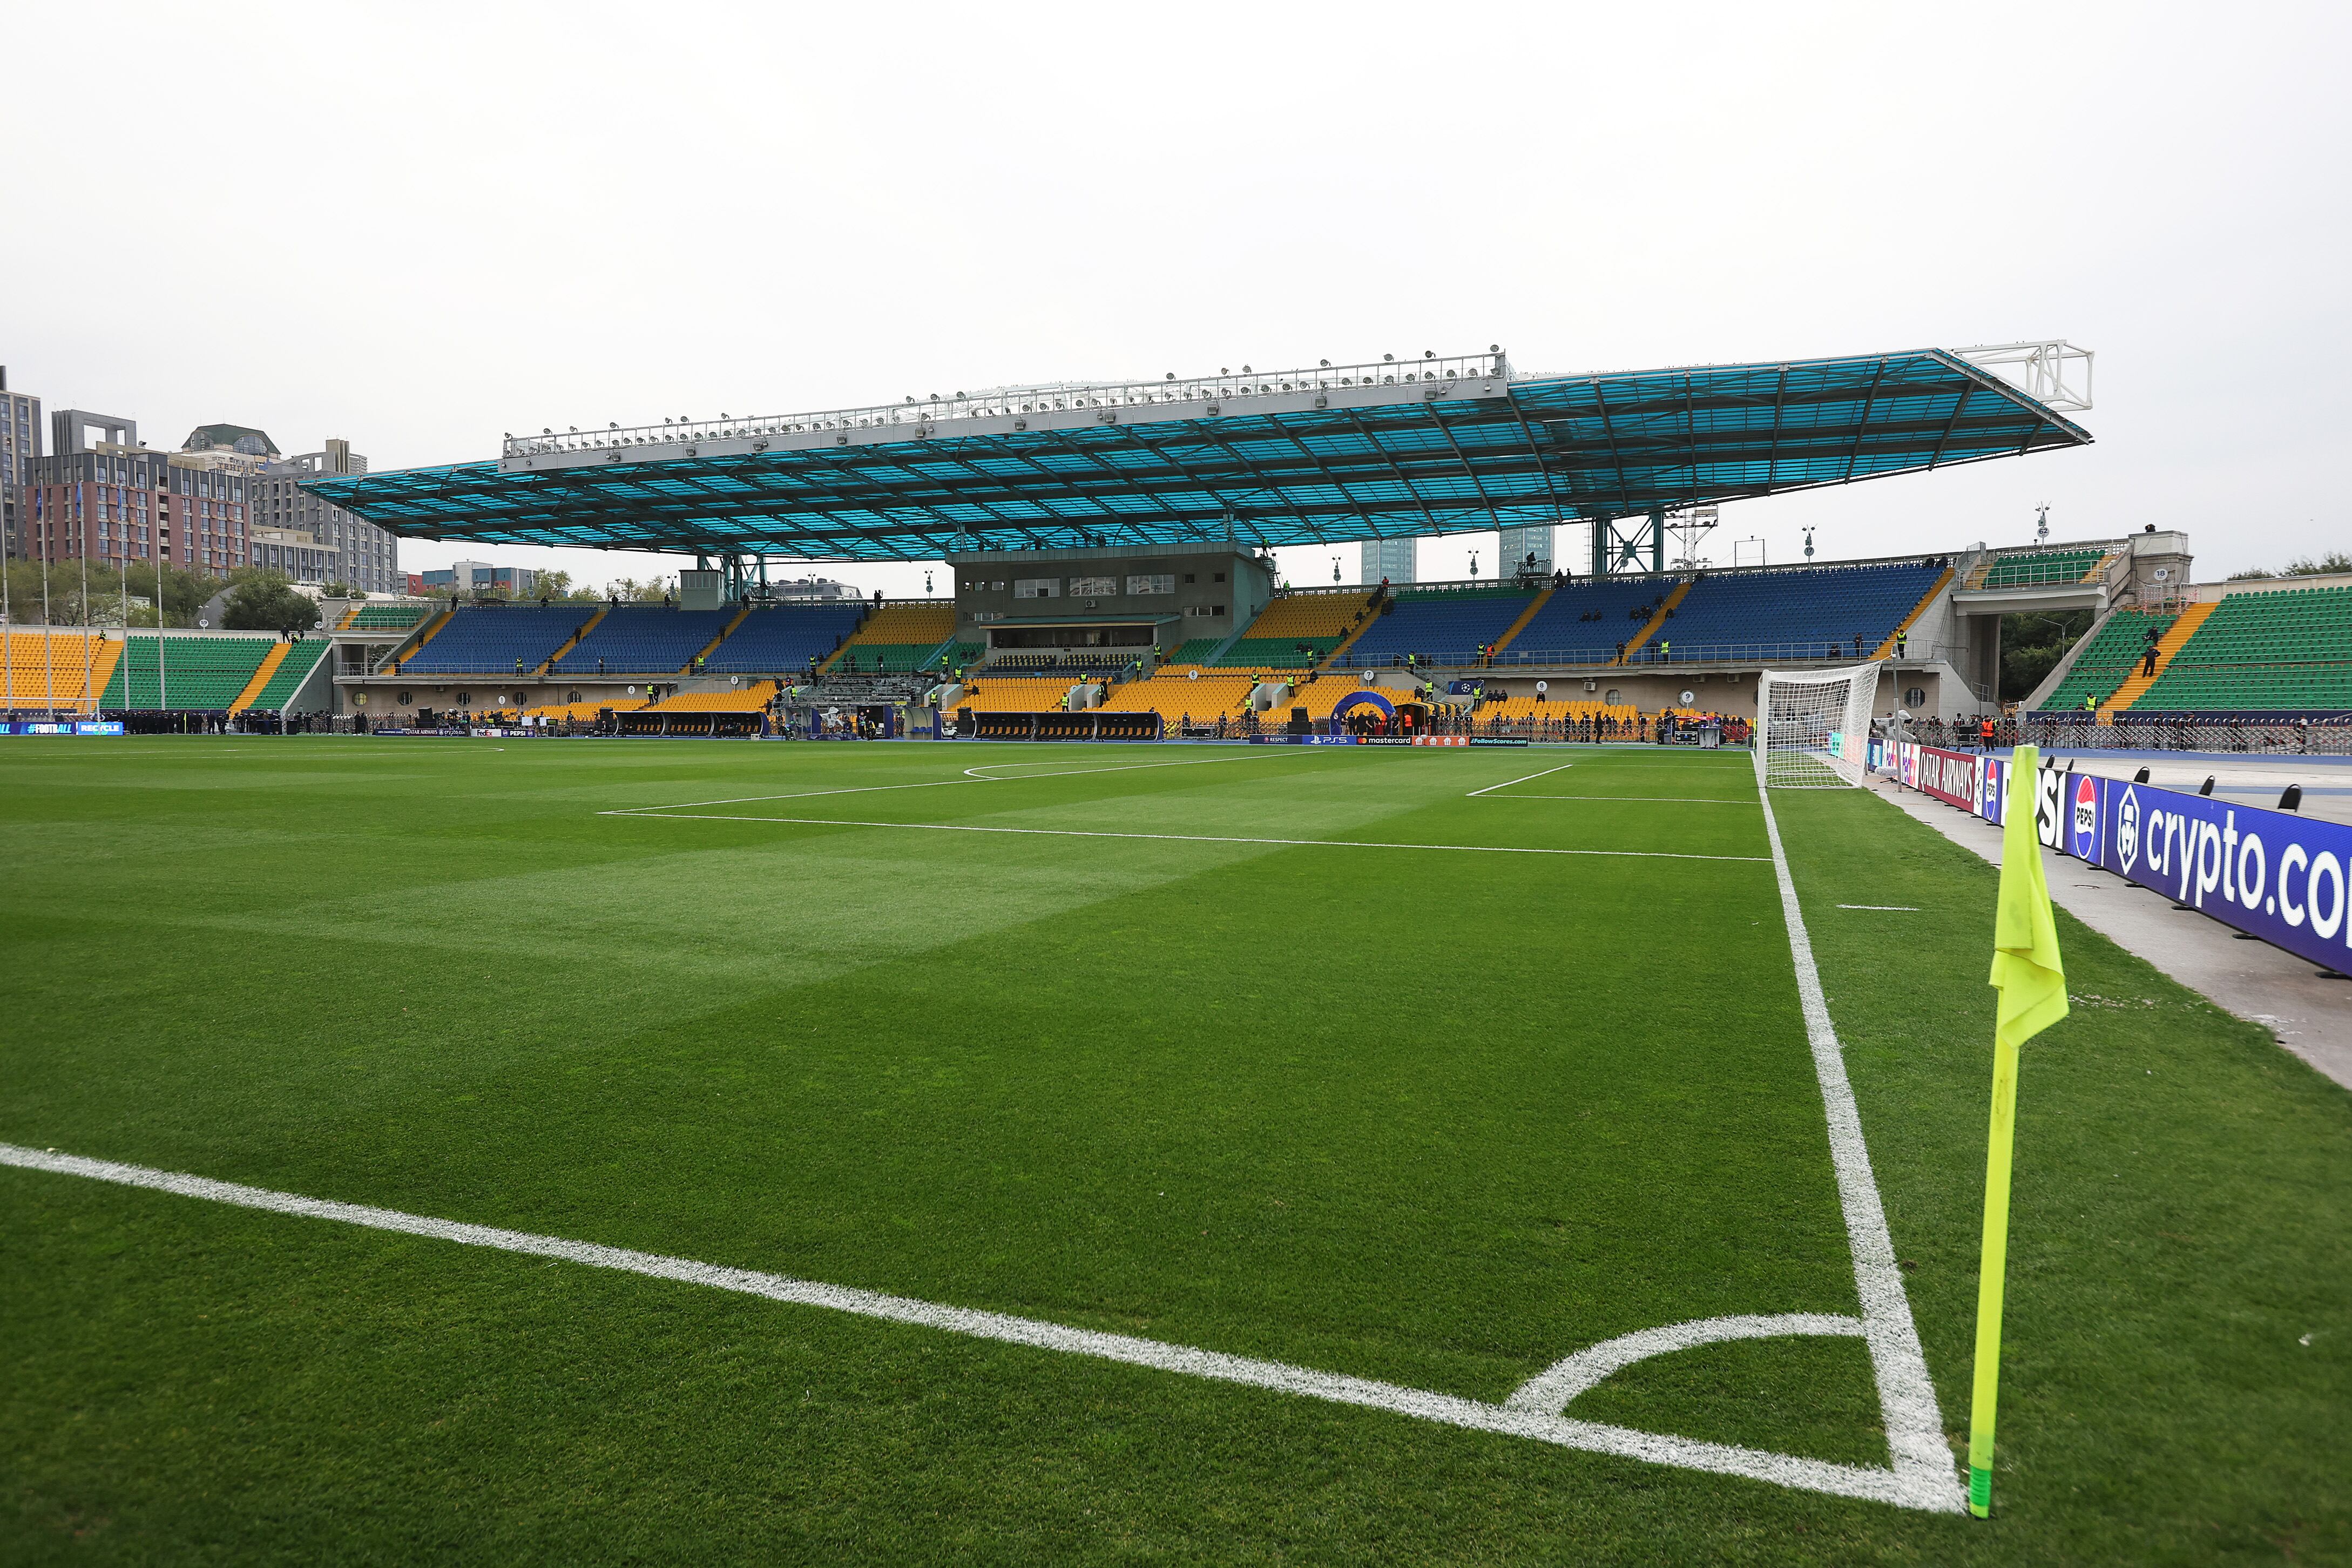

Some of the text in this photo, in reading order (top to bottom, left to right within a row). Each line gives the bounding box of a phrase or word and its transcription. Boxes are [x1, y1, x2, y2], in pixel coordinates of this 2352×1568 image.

[28, 724, 72, 734] #FOOTBALL
[1920, 752, 1940, 791] QATAR
[1941, 757, 1973, 802] AIRWAYS
[2077, 806, 2094, 828] PEPSI
[2146, 808, 2352, 949] crypto.co
